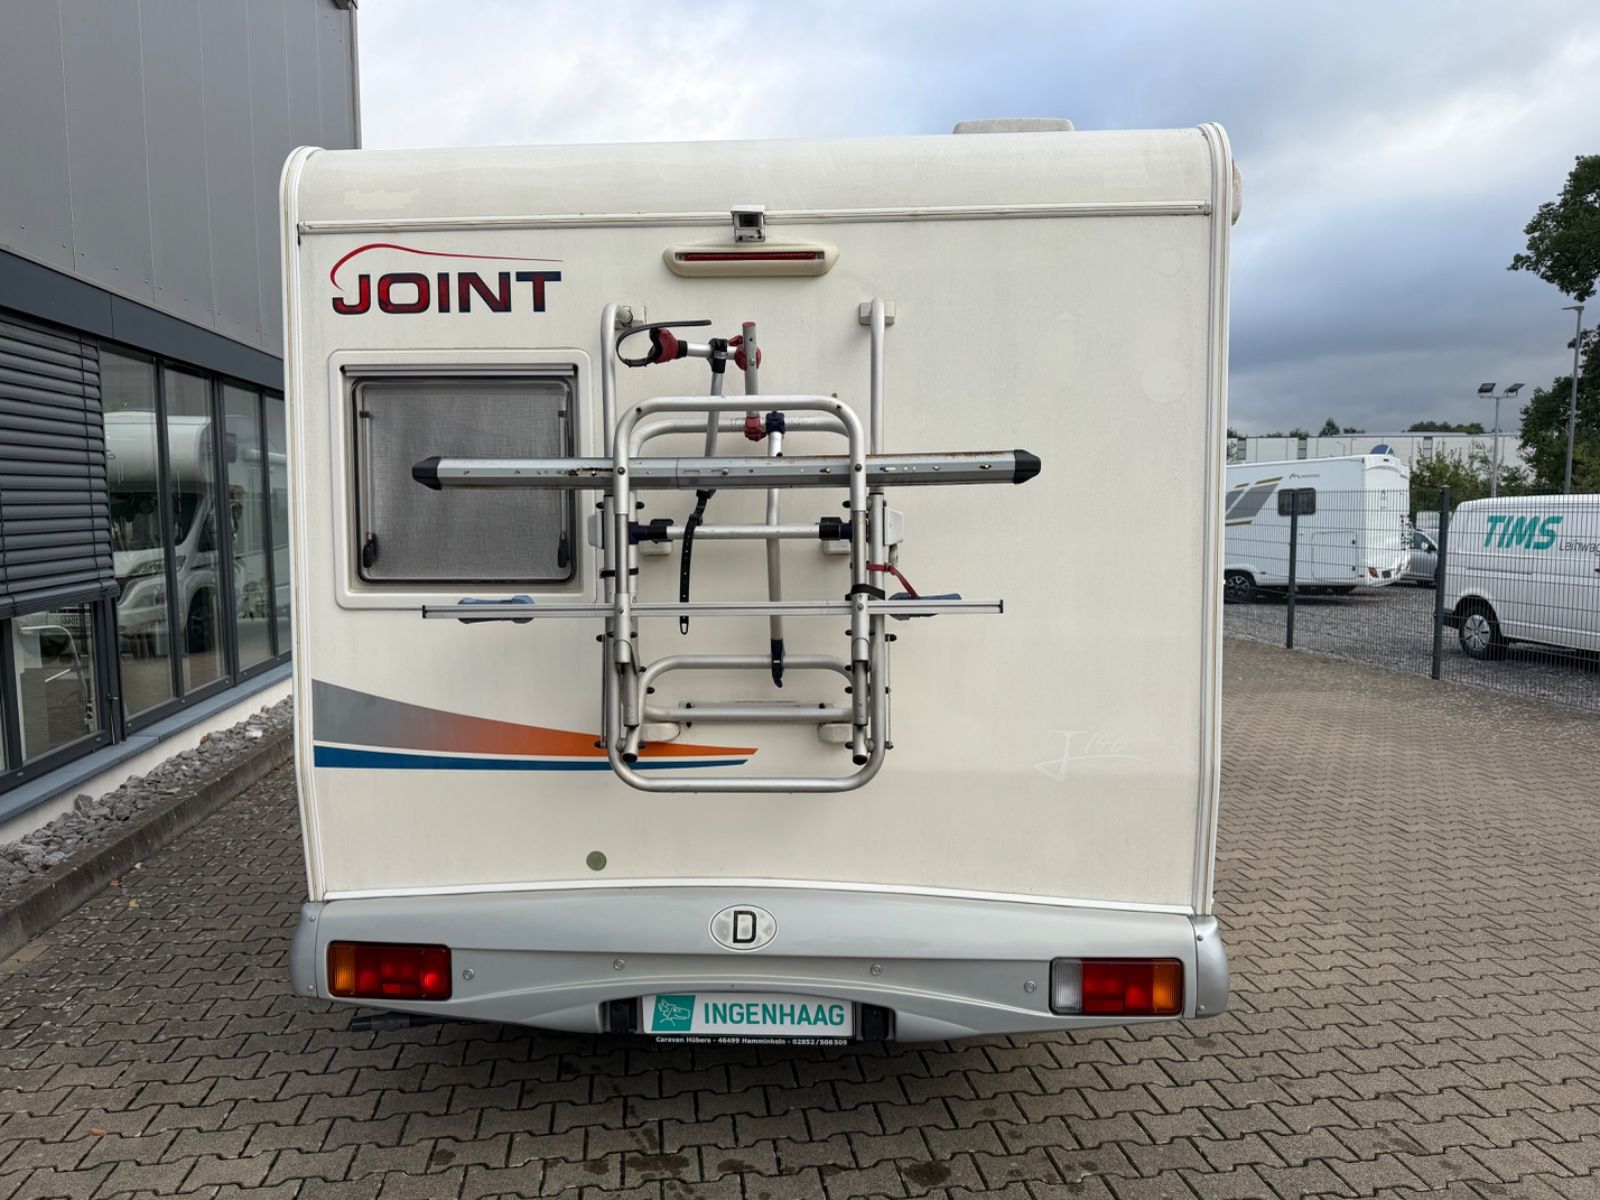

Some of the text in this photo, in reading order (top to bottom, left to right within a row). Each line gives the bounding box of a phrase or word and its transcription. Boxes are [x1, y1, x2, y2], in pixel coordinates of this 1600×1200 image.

[332, 271, 562, 315] JOINT
[1484, 515, 1564, 550] TIMS
[733, 910, 757, 943] D
[704, 1003, 845, 1026] INGENHAAG
